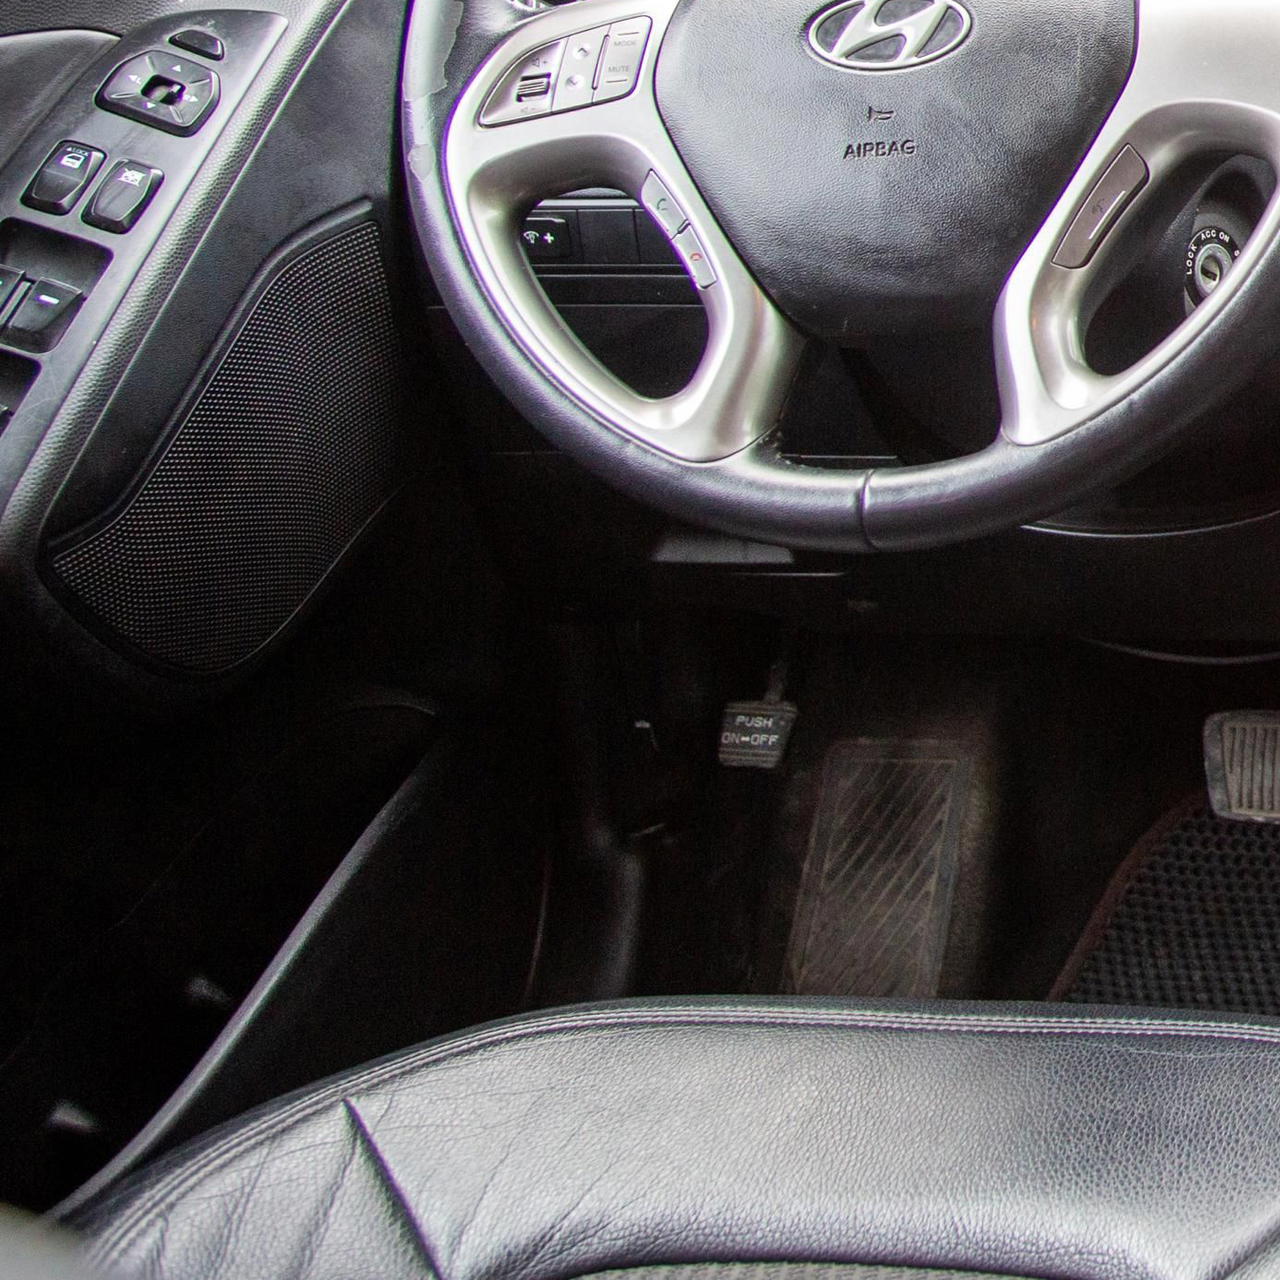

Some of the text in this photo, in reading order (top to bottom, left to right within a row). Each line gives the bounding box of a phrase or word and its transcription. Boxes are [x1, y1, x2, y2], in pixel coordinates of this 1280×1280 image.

[842, 139, 916, 160] AIRBAG
[1186, 229, 1231, 275] LOCK ACC ON
[734, 714, 774, 728] PUSH
